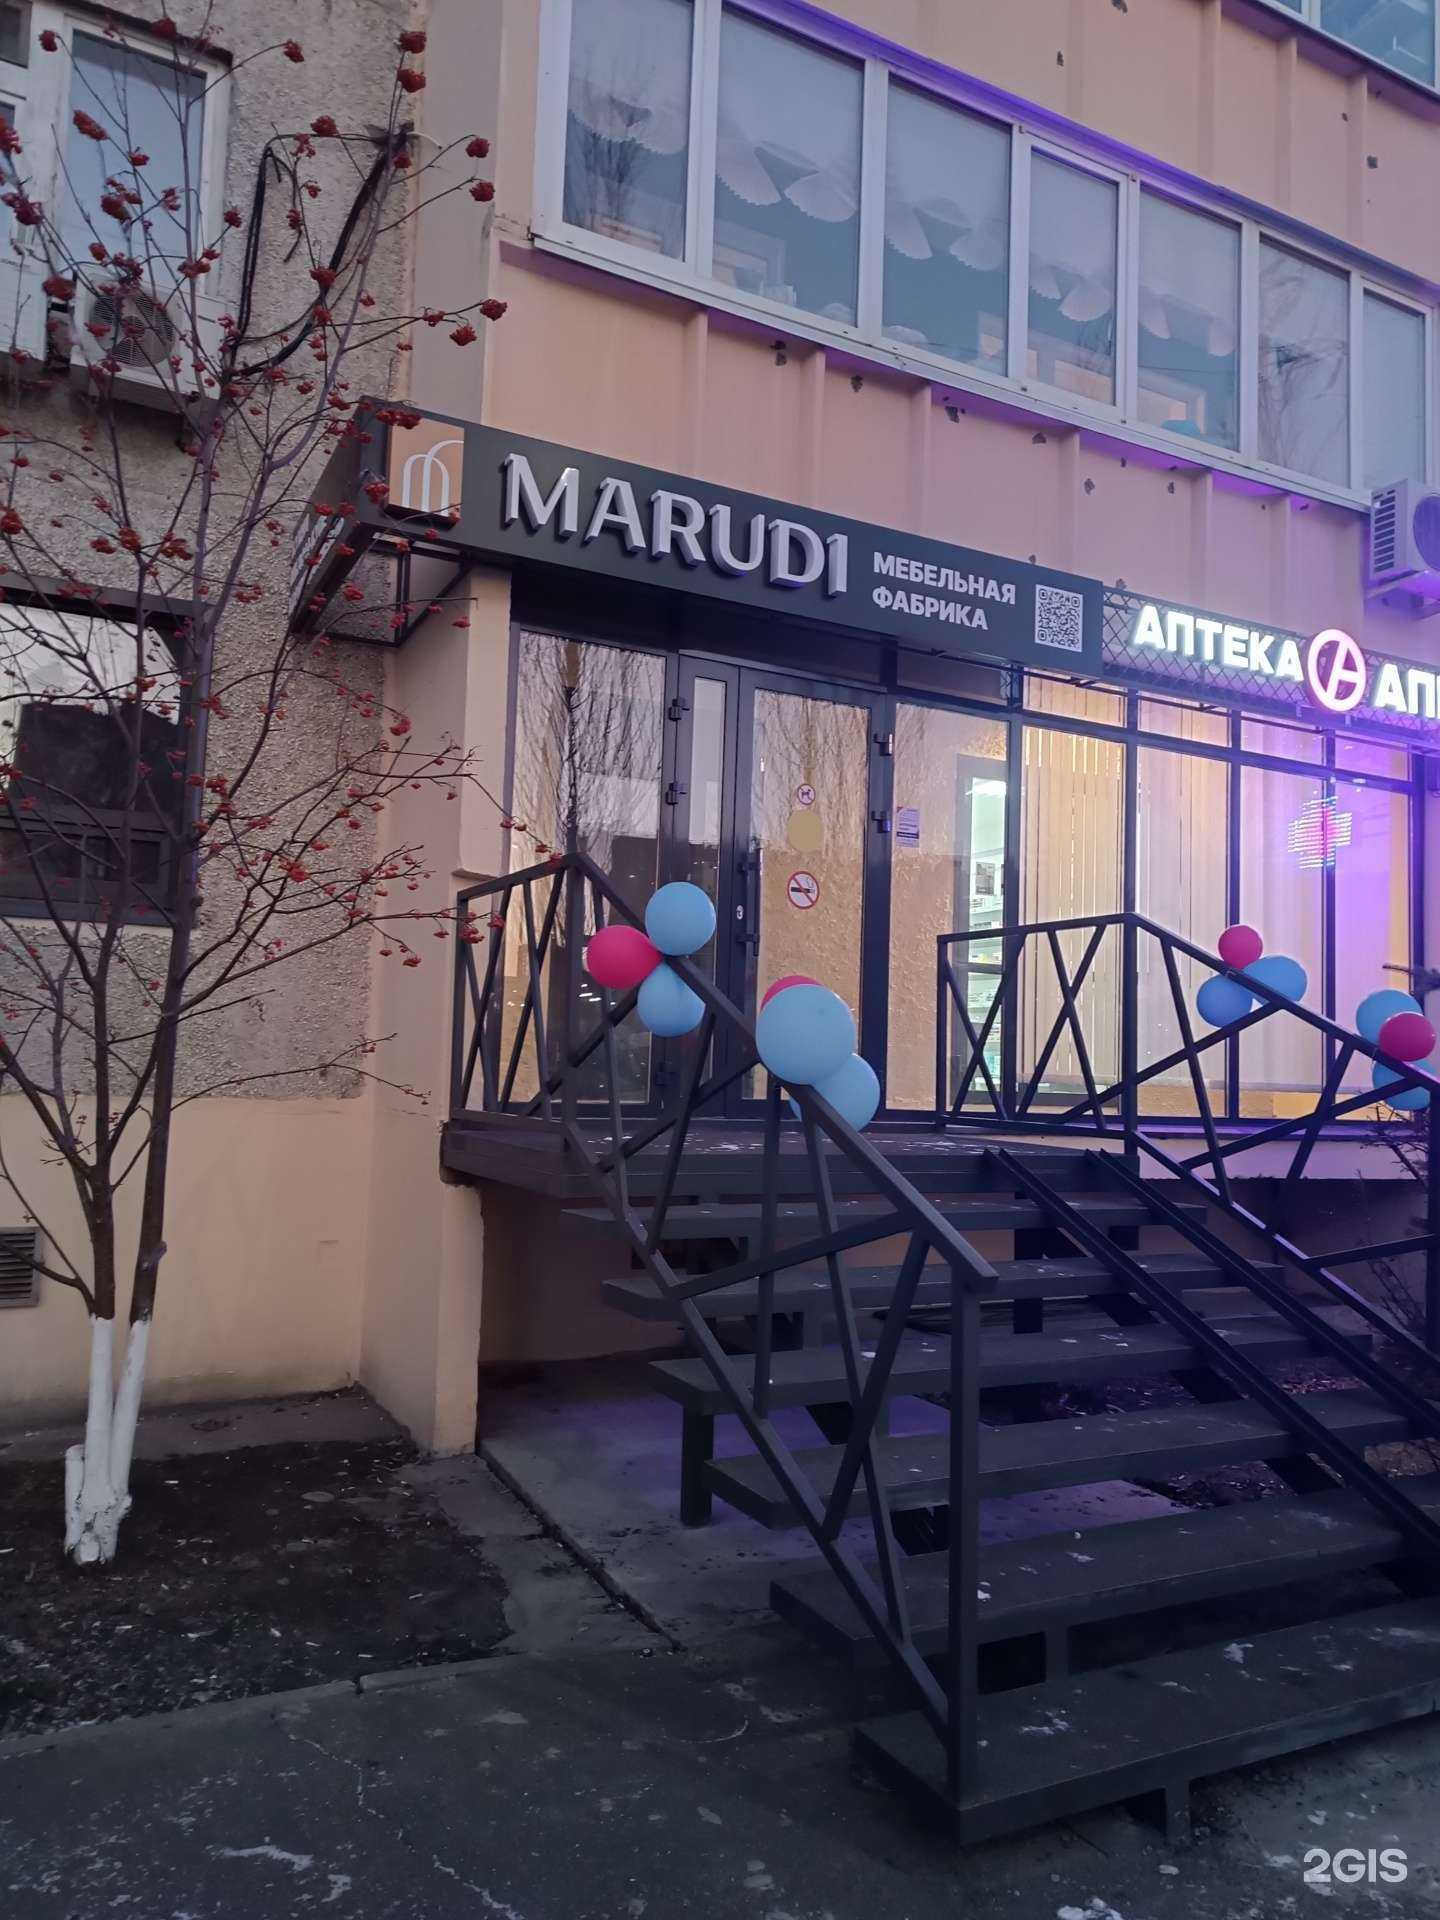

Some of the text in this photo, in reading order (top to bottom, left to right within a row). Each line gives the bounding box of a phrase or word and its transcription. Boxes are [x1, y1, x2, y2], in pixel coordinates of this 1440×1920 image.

[503, 452, 849, 599] MARUDI
[871, 585, 989, 631] ФАБРИКА
[873, 551, 1017, 605] МЕБЕЛЬНАЯ
[1133, 602, 1305, 683] АПТЕКА
[1373, 662, 1440, 721] АП
